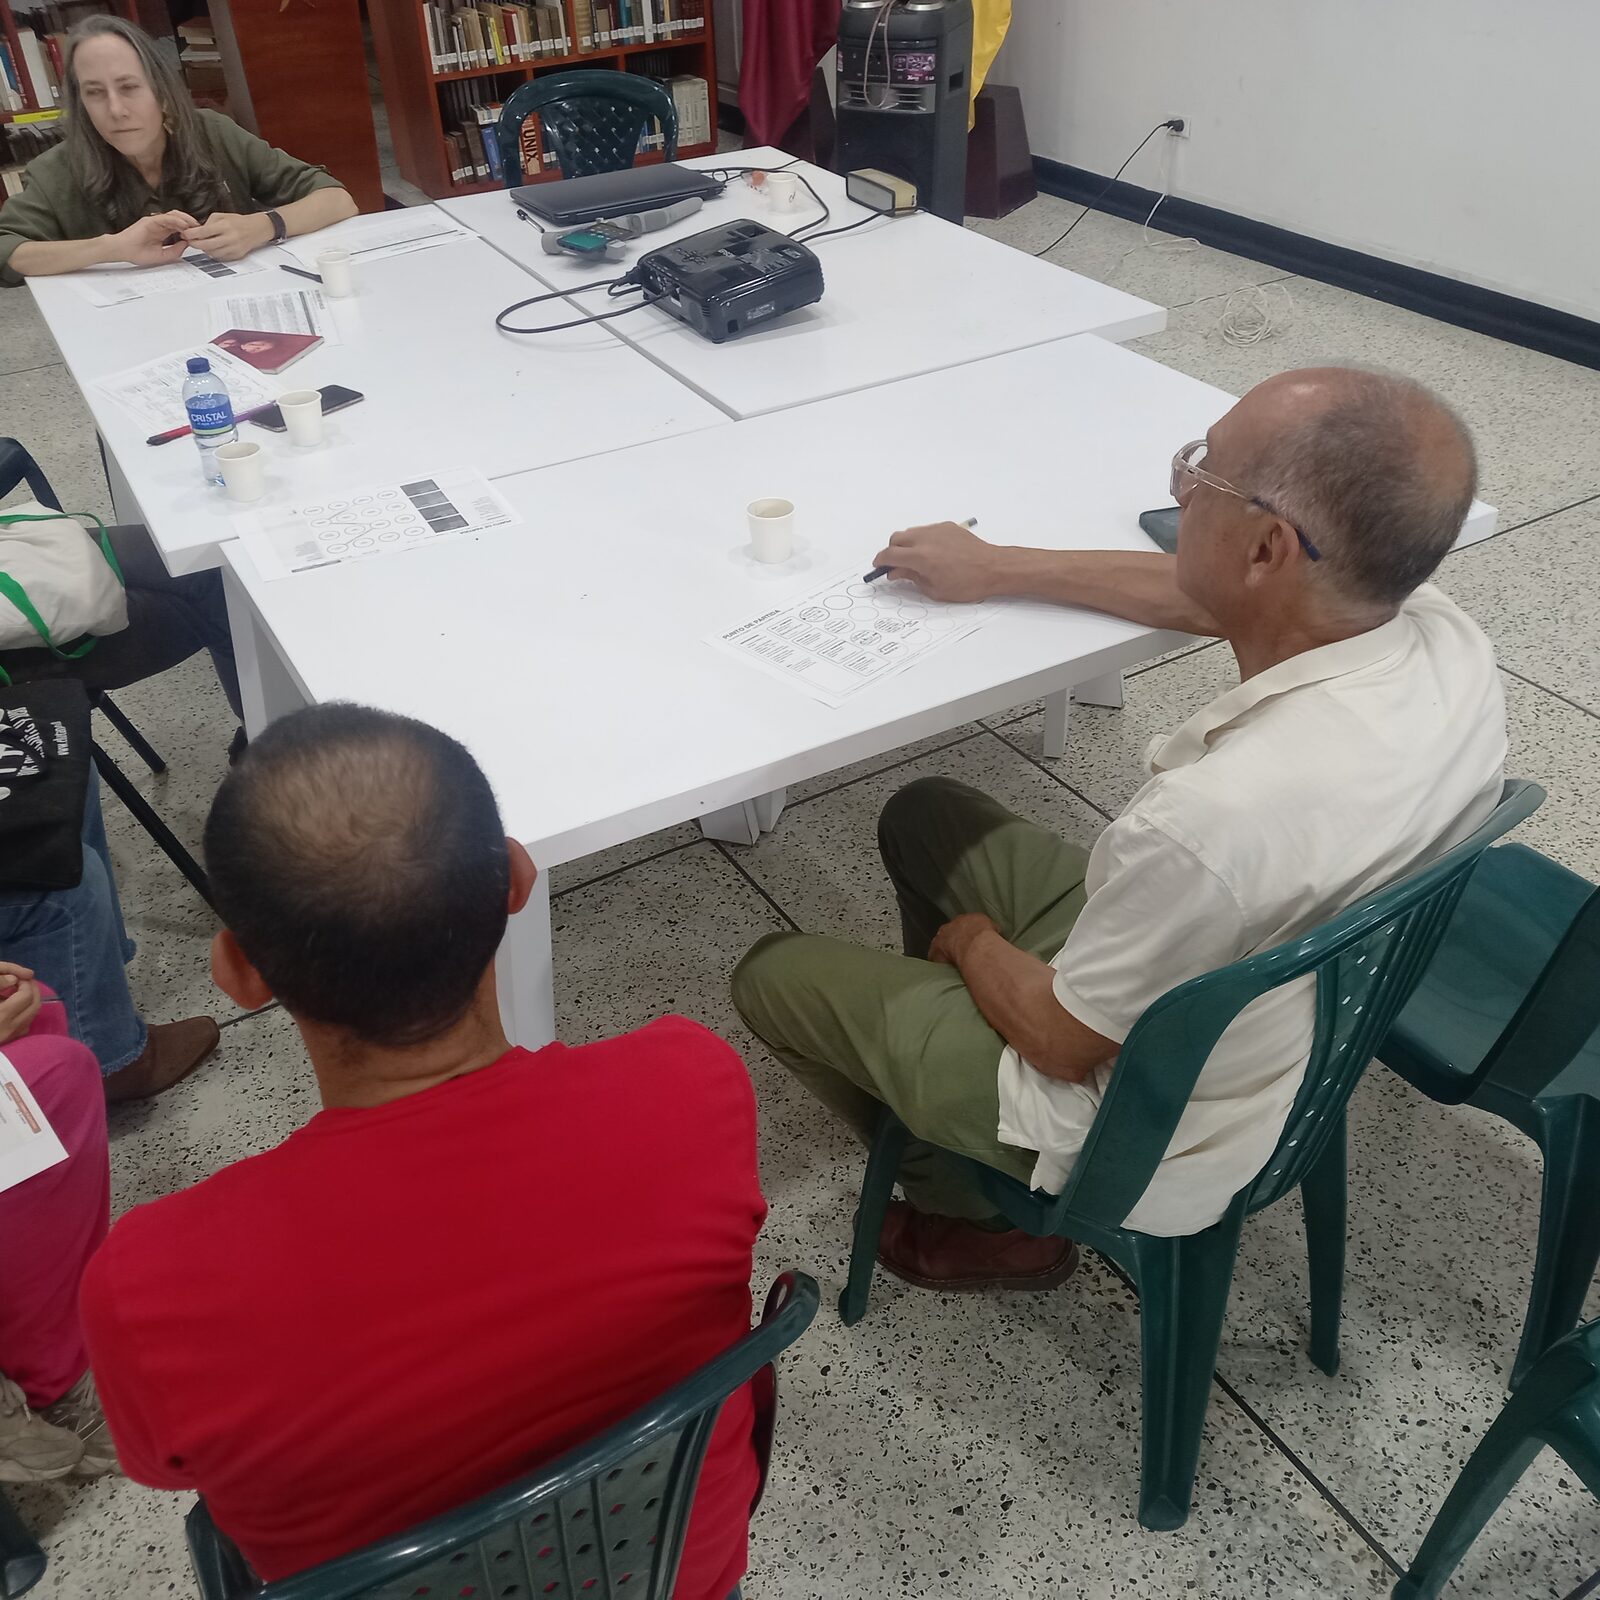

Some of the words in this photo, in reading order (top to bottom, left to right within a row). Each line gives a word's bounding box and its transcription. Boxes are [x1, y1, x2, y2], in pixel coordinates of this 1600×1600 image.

[523, 129, 539, 163] UNIX
[190, 411, 228, 422] CRISTAL
[722, 628, 745, 639] PUNTO
[753, 609, 781, 624] PARTIDA
